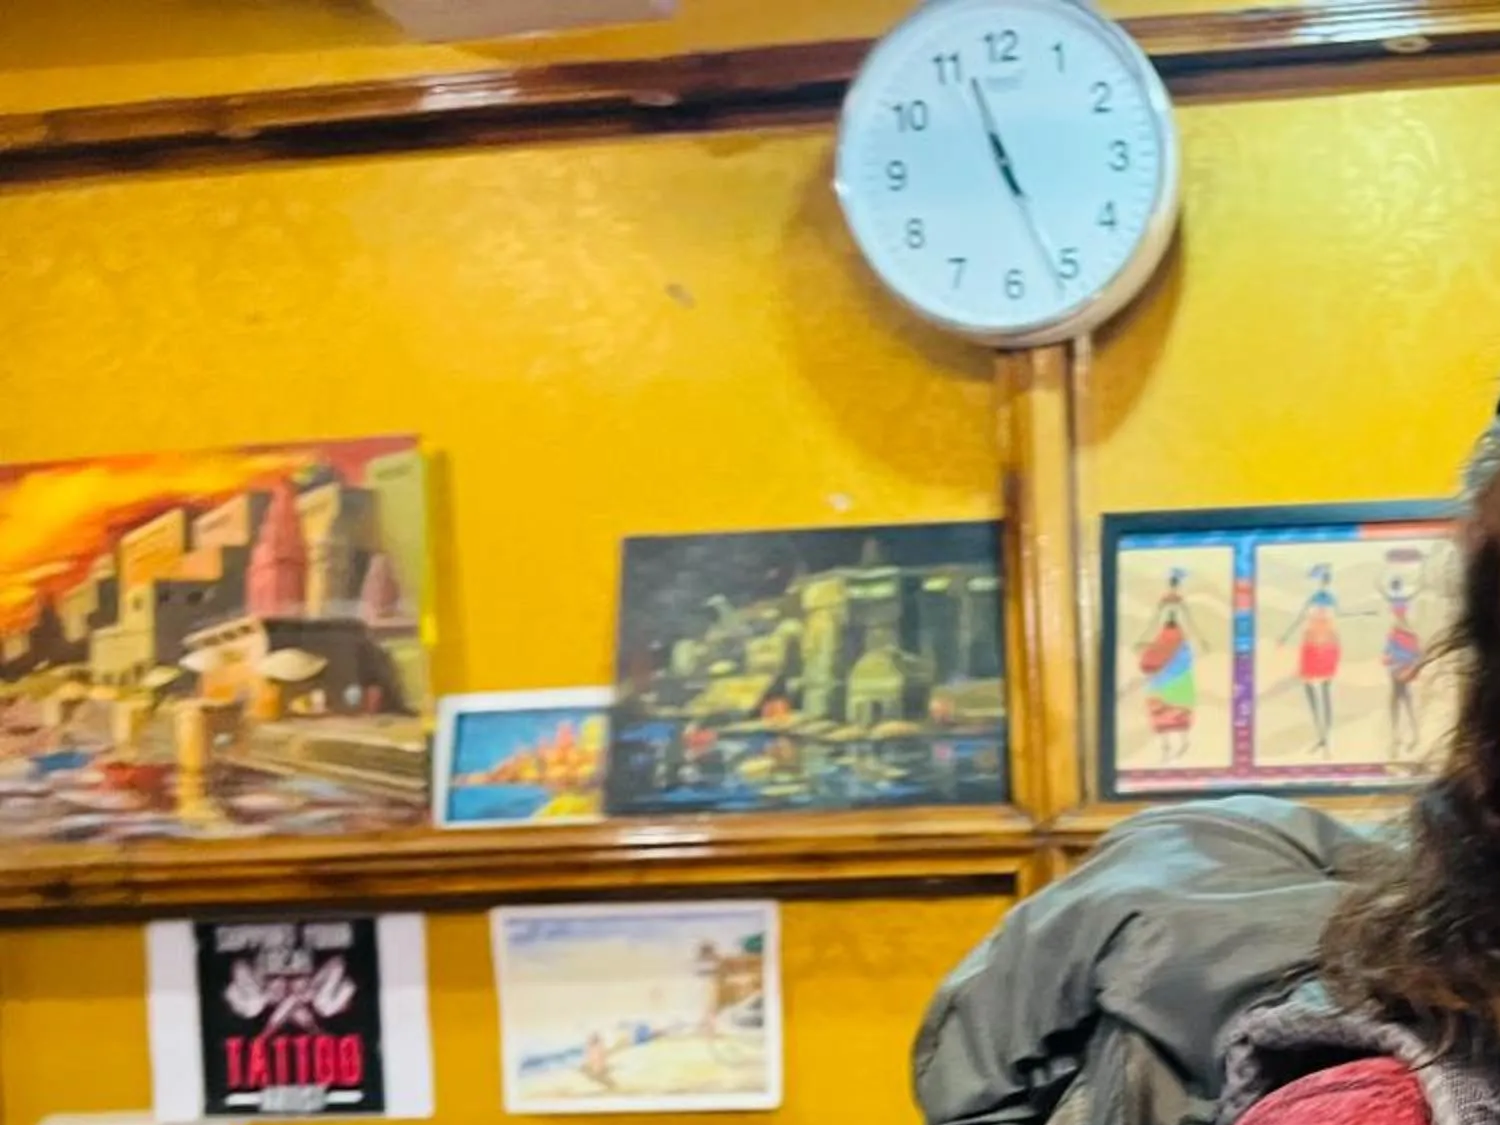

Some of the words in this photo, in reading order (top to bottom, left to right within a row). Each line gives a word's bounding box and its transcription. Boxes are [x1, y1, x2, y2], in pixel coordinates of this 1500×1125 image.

[983, 29, 1019, 63] 12
[1052, 42, 1066, 73] 1
[932, 53, 961, 85] 11
[1090, 81, 1113, 114] 2
[892, 100, 928, 132] 10
[1108, 140, 1130, 172] 3
[886, 160, 907, 191] 9
[1097, 201, 1117, 232] 4
[905, 218, 925, 250] 8
[948, 257, 967, 289] 7
[1058, 248, 1080, 280] 5
[1004, 269, 1025, 300] 6
[225, 1034, 364, 1088] TATTOO
